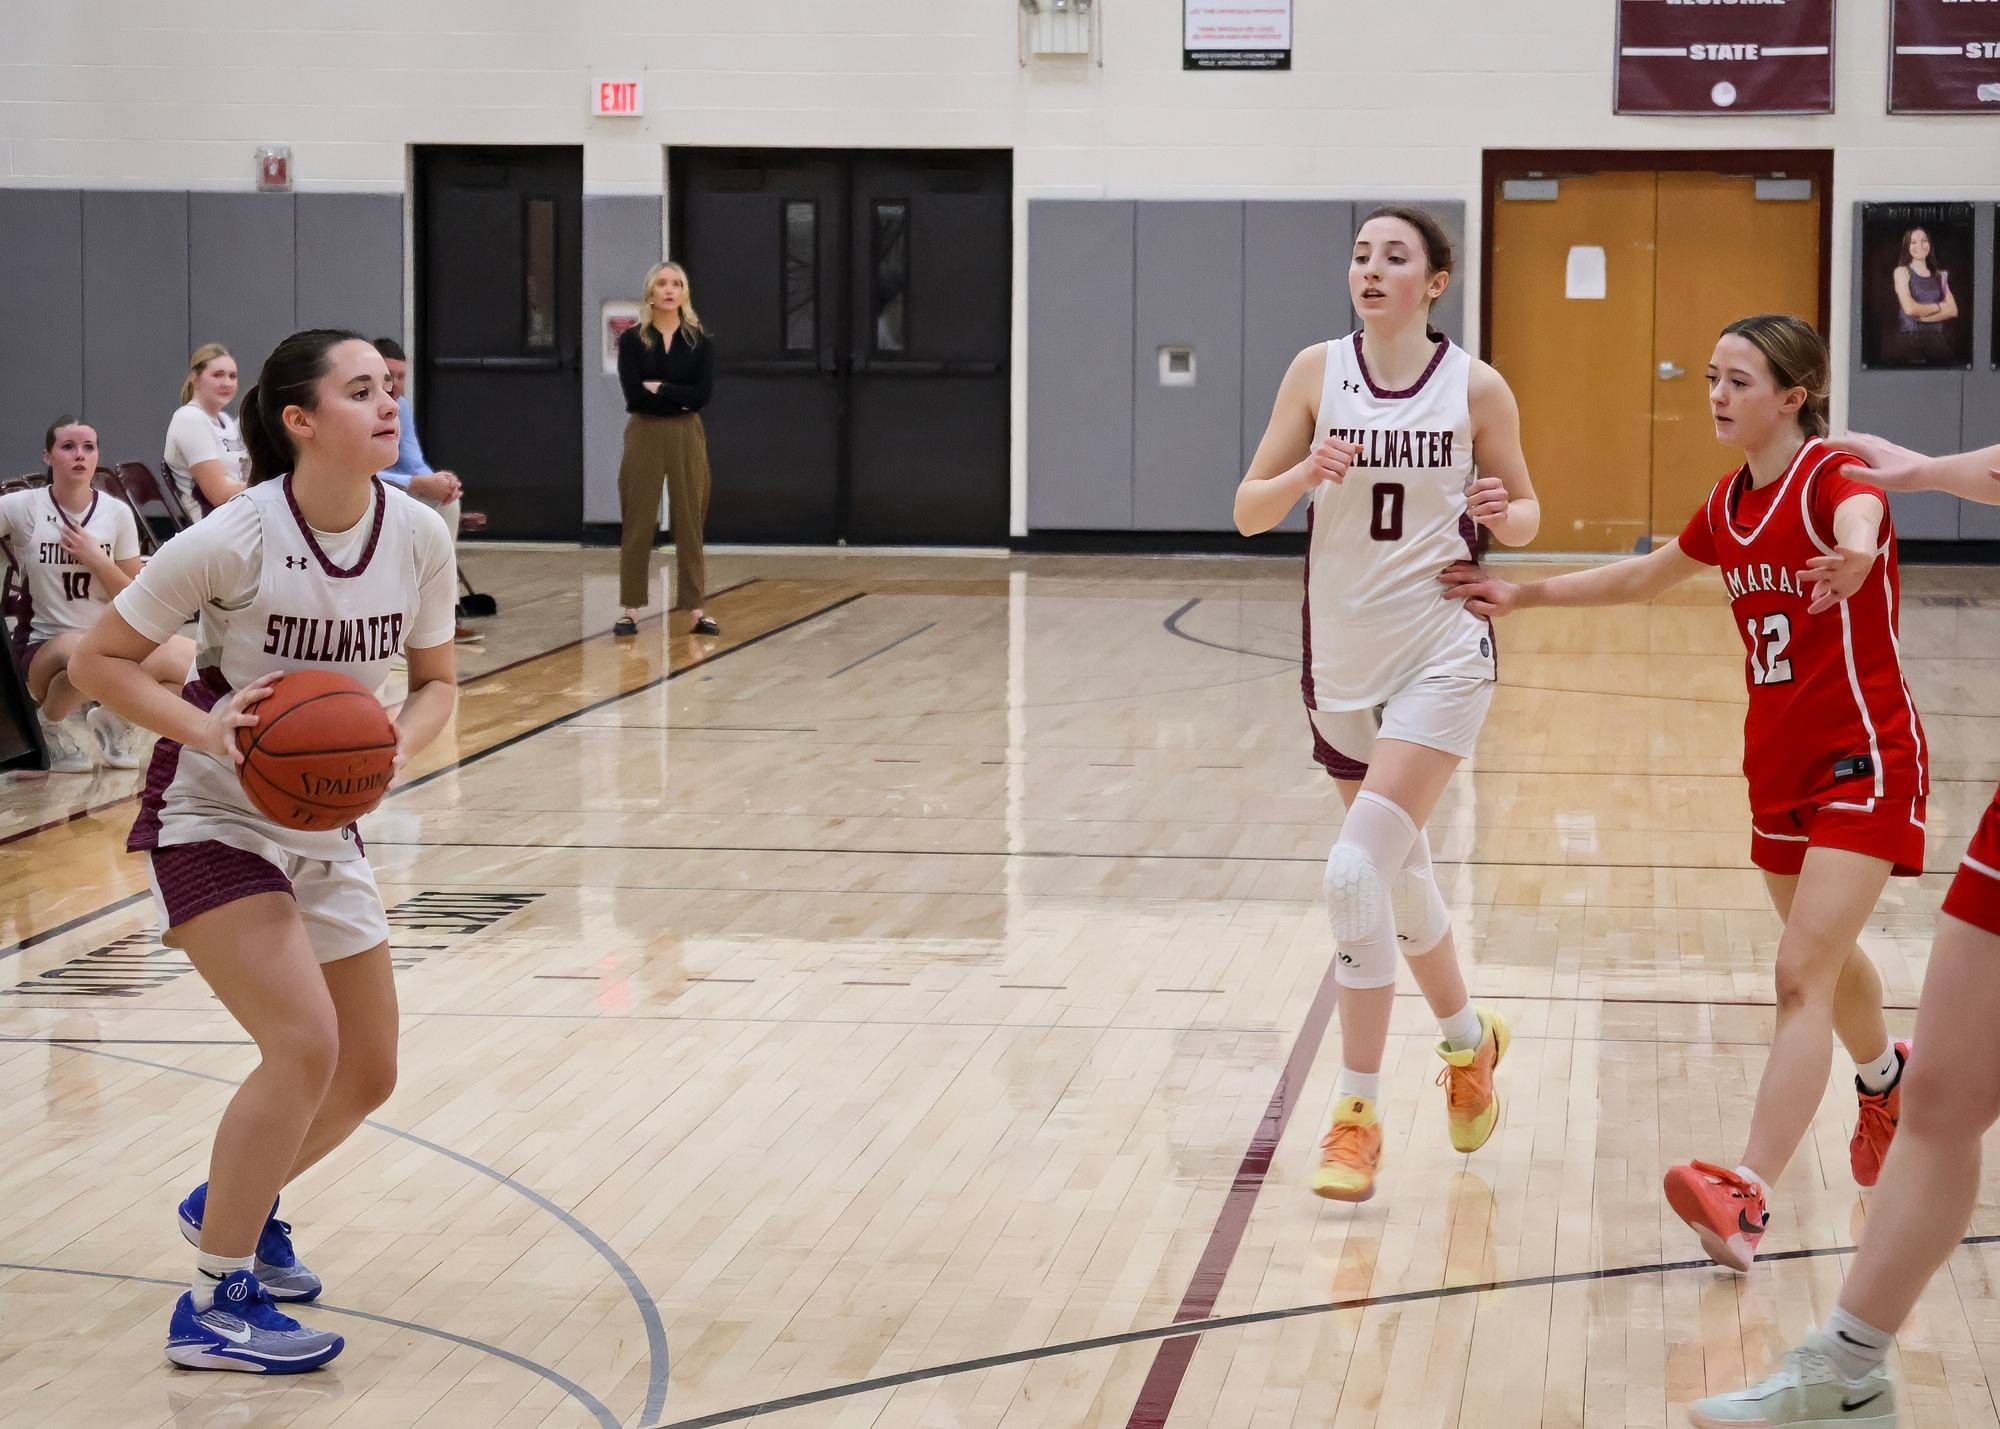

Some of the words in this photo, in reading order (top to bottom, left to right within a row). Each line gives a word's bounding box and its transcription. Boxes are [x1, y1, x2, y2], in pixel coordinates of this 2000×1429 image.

[1689, 43, 1759, 60] STATE
[600, 82, 637, 112] EXIT
[1369, 482, 1405, 541] 0
[62, 571, 92, 601] 10
[263, 612, 403, 663] STILLWATER
[1747, 613, 1793, 685] 12
